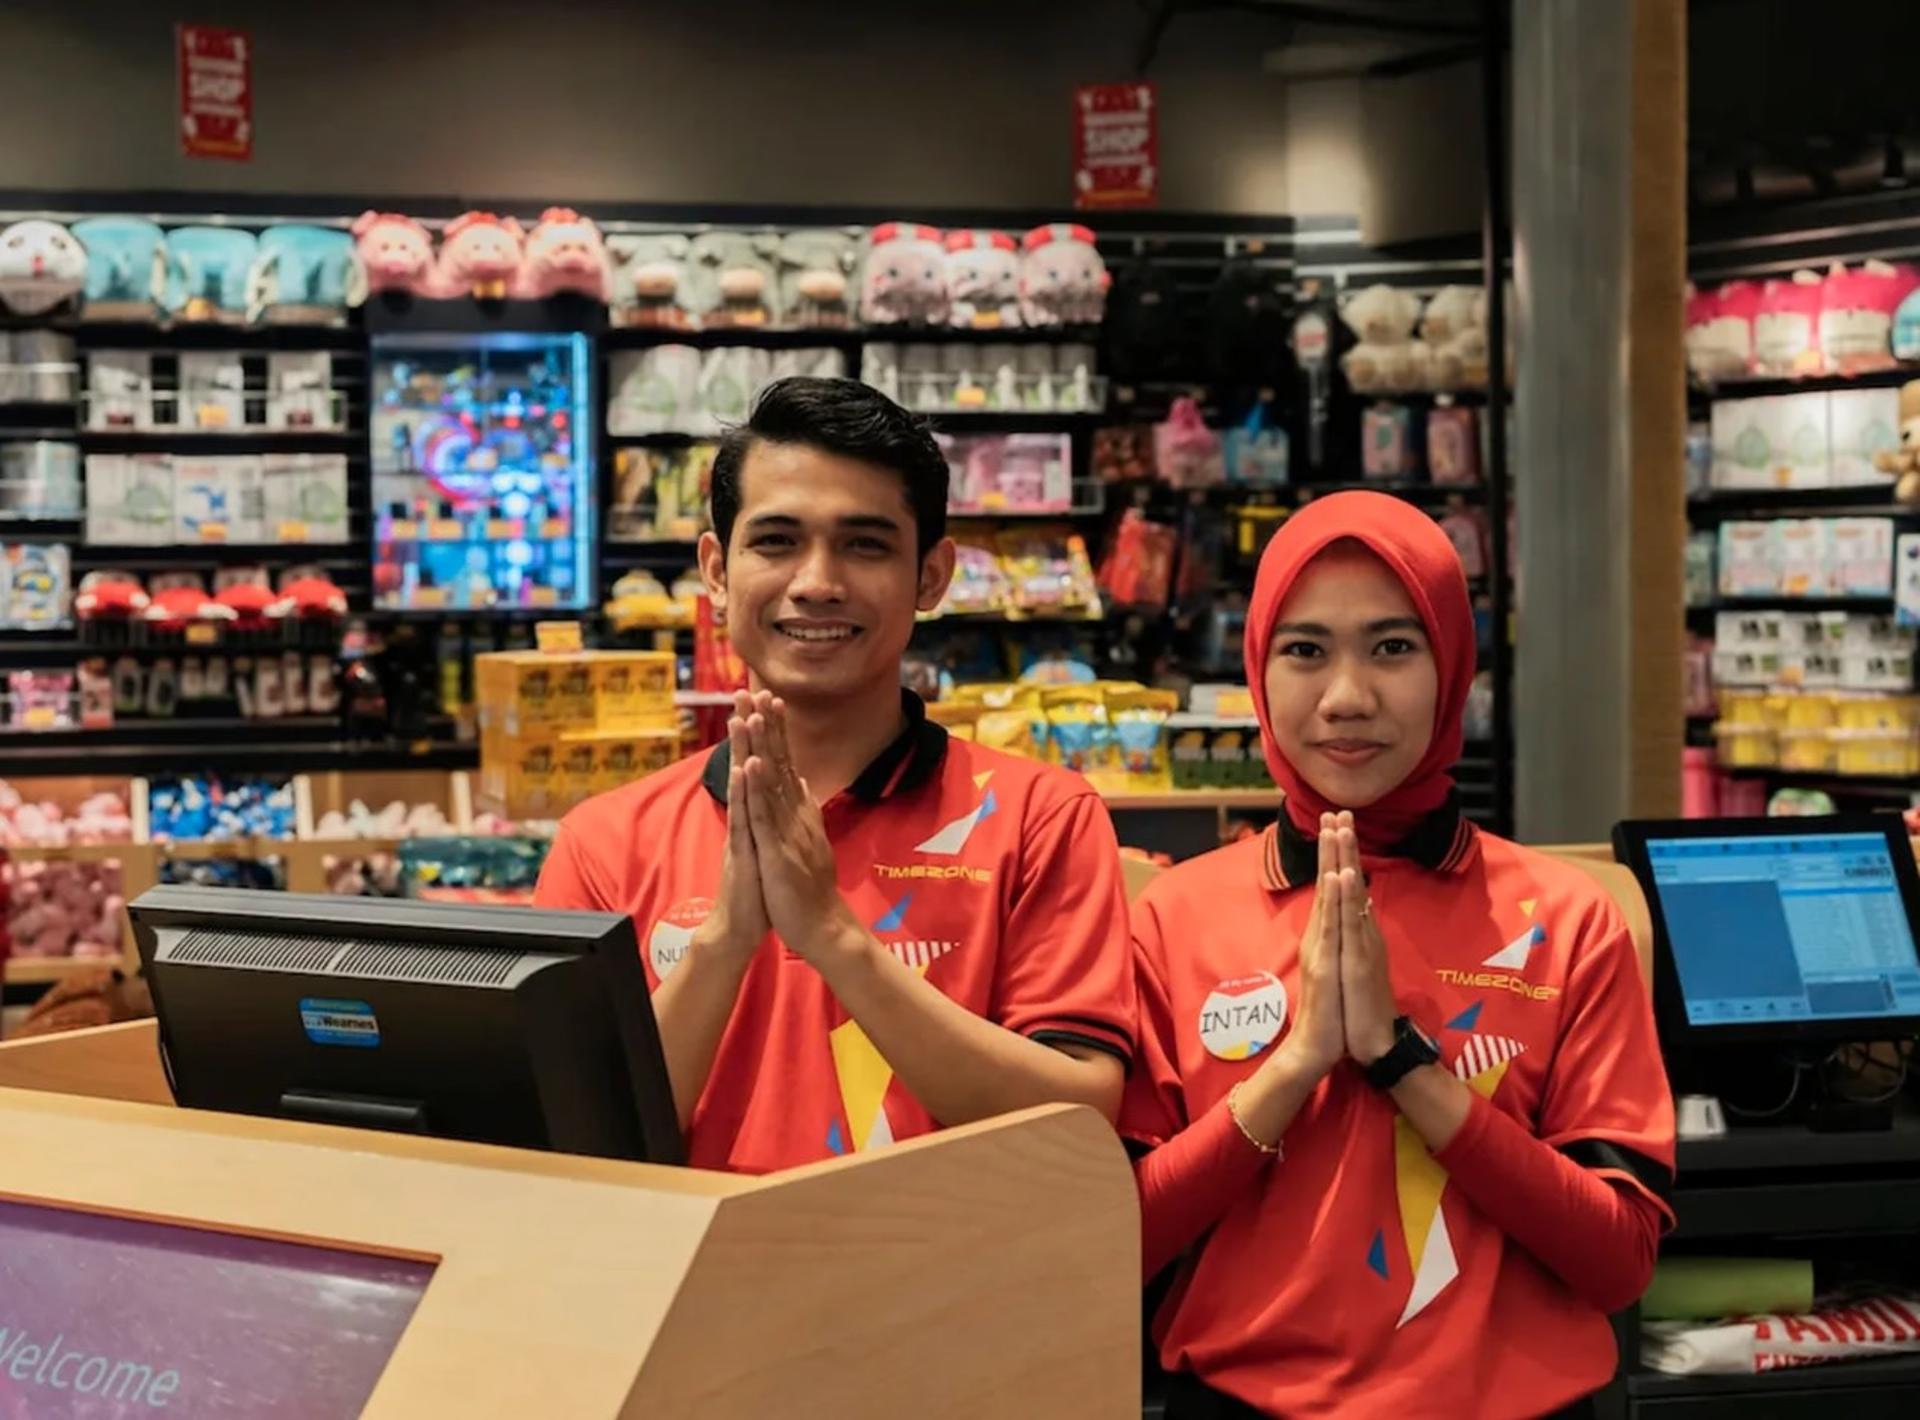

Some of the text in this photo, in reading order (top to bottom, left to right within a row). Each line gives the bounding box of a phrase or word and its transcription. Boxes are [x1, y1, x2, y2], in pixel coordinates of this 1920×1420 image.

[190, 74, 246, 99] SHOP
[1085, 127, 1148, 151] SHOP
[873, 864, 992, 882] TIMEZONE
[1435, 969, 1559, 1000] TIMEZONE
[1201, 1000, 1281, 1034] INTAN
